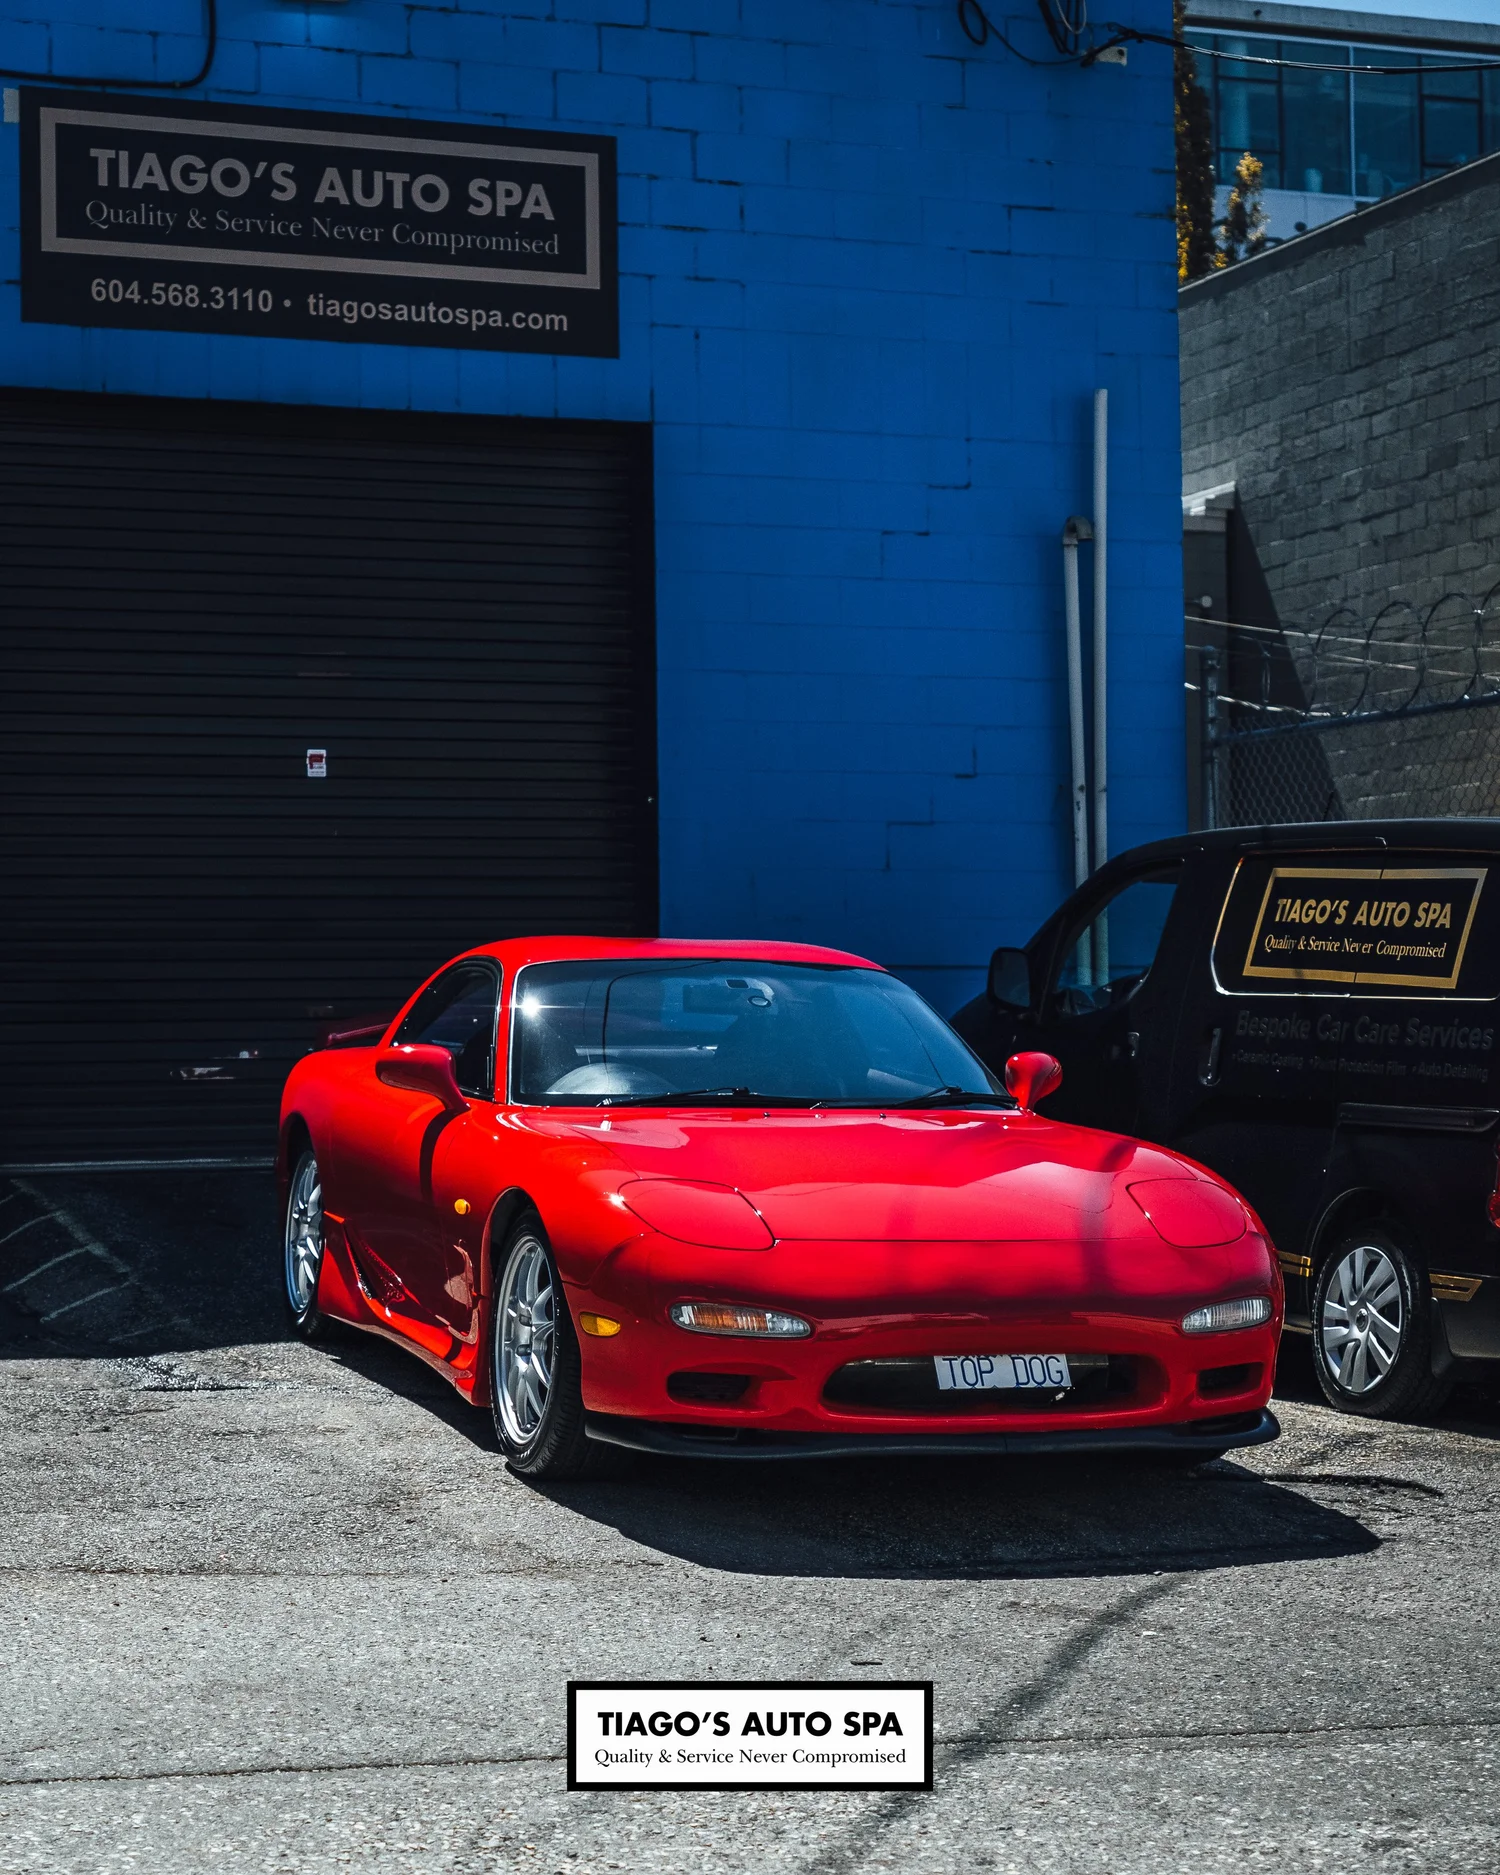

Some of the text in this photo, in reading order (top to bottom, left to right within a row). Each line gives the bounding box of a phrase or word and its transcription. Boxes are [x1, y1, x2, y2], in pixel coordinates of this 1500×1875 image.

[90, 147, 555, 221] TIAGO'S AUTO SPA
[85, 200, 560, 256] Quality & Service Never Compromised
[90, 278, 569, 332] 604.568.3110 tiagosautospa.com
[1274, 899, 1452, 929] TIAGO'S AUTO SPA
[1264, 934, 1447, 960] Quality & Service Never Compromised
[1236, 1010, 1494, 1050] Bespoke Car Care Services
[1338, 1058, 1384, 1075] Protection
[1386, 1061, 1407, 1076] Film
[1417, 1062, 1441, 1077] Auto
[1443, 1063, 1487, 1083] Detailing
[942, 1356, 1064, 1387] TOP DOG
